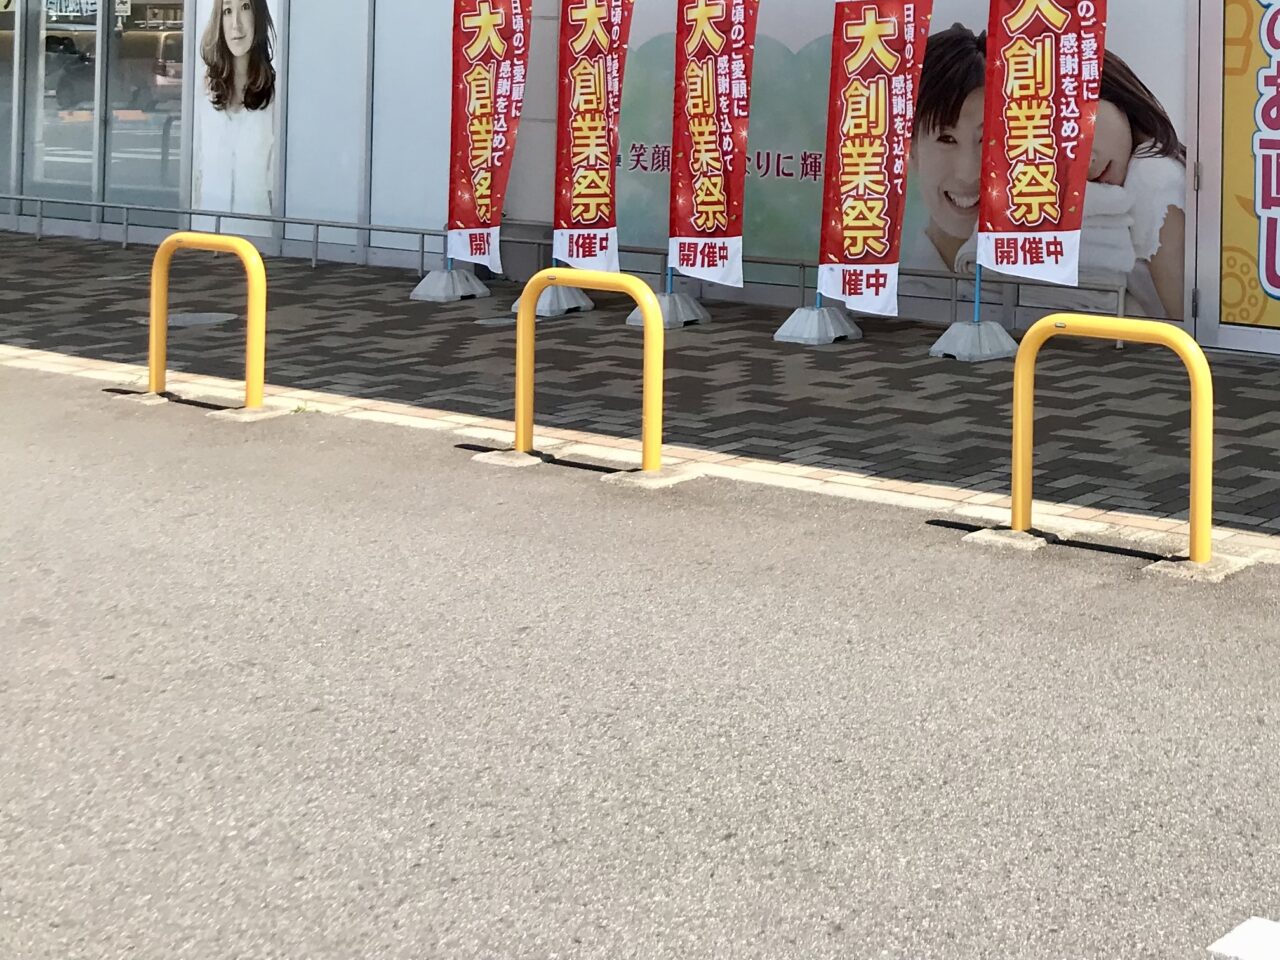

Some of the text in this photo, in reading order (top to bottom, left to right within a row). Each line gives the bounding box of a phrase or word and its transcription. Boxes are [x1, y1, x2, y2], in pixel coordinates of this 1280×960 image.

[492, 60, 511, 166] 感謝を込めて
[717, 55, 735, 172] 感謝を込めて
[841, 5, 901, 260] 大創業祭
[891, 74, 905, 195] 感謝を込めて
[1059, 33, 1080, 160] 感謝を込めて
[679, 242, 729, 268] 開催中
[994, 237, 1065, 266] 開催中
